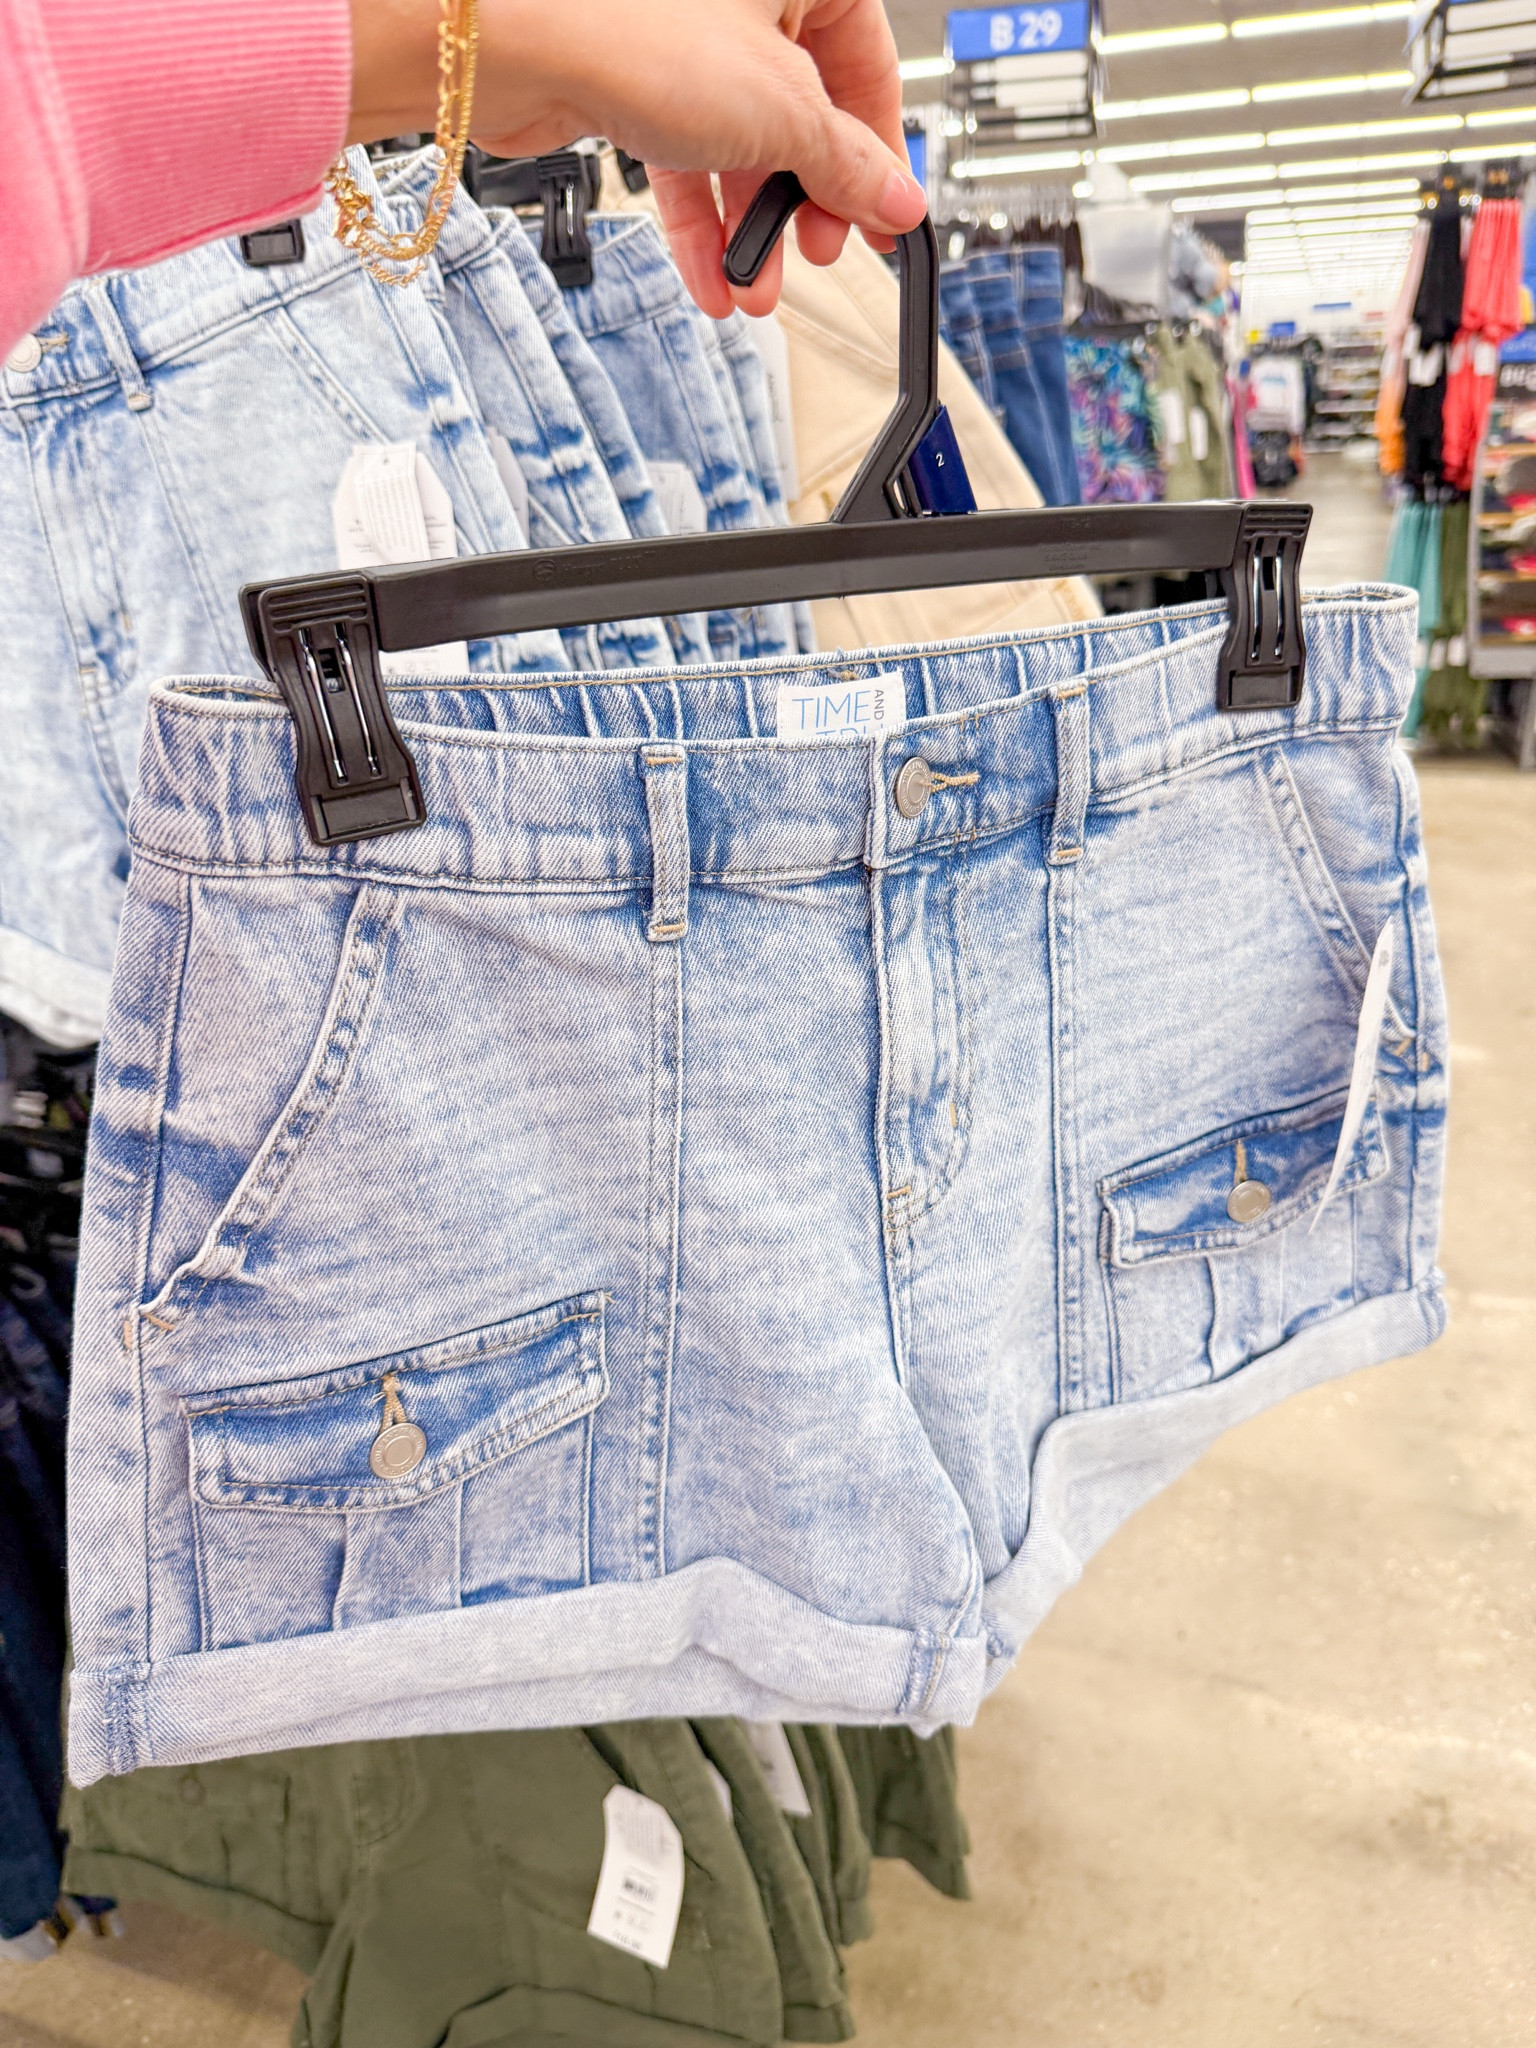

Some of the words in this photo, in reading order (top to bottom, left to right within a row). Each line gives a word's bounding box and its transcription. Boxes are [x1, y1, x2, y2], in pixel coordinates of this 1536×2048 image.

[989, 13, 1015, 51] B
[1018, 9, 1063, 49] 29
[935, 453, 945, 468] 2
[791, 690, 872, 730] TIME
[873, 689, 885, 721] AND
